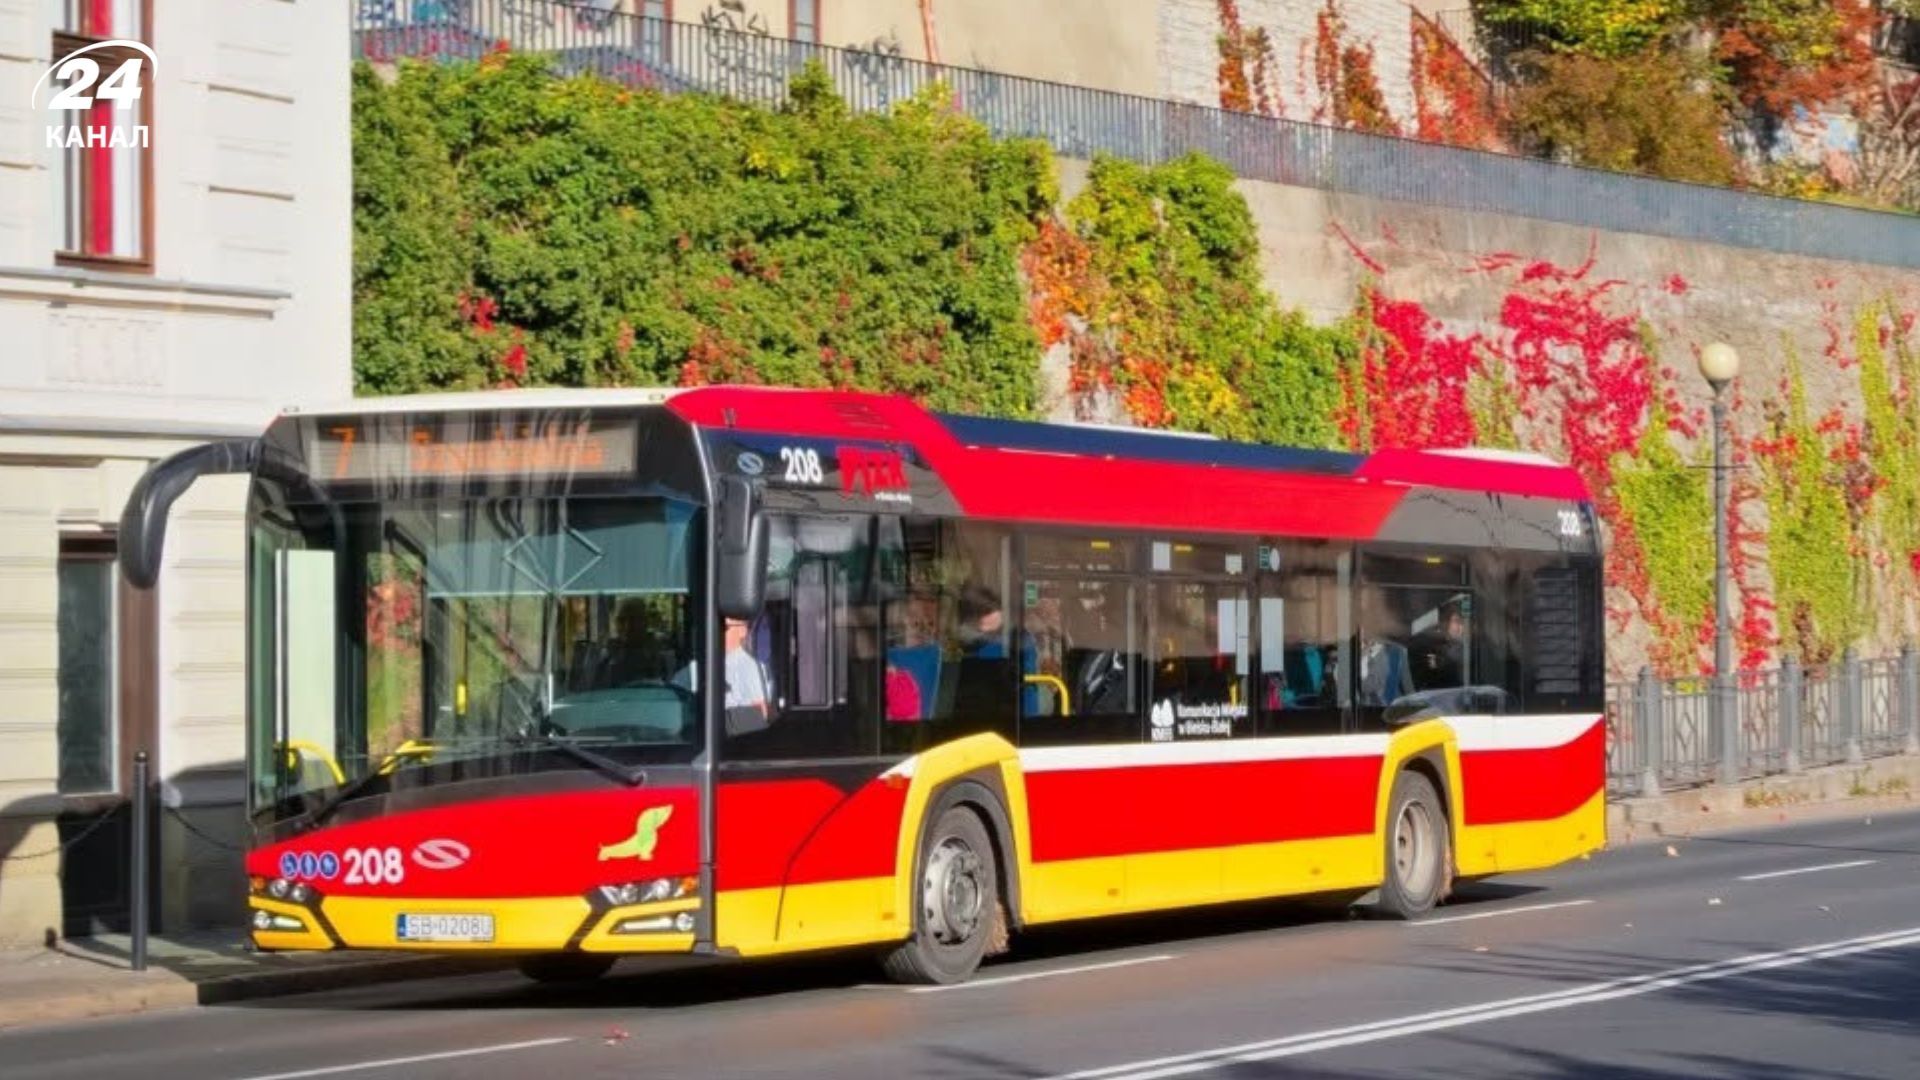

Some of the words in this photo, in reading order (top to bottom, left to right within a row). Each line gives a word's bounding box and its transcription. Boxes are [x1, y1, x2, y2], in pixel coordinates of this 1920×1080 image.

[330, 427, 355, 479] 7
[781, 446, 823, 483] 208
[343, 847, 405, 885] 208
